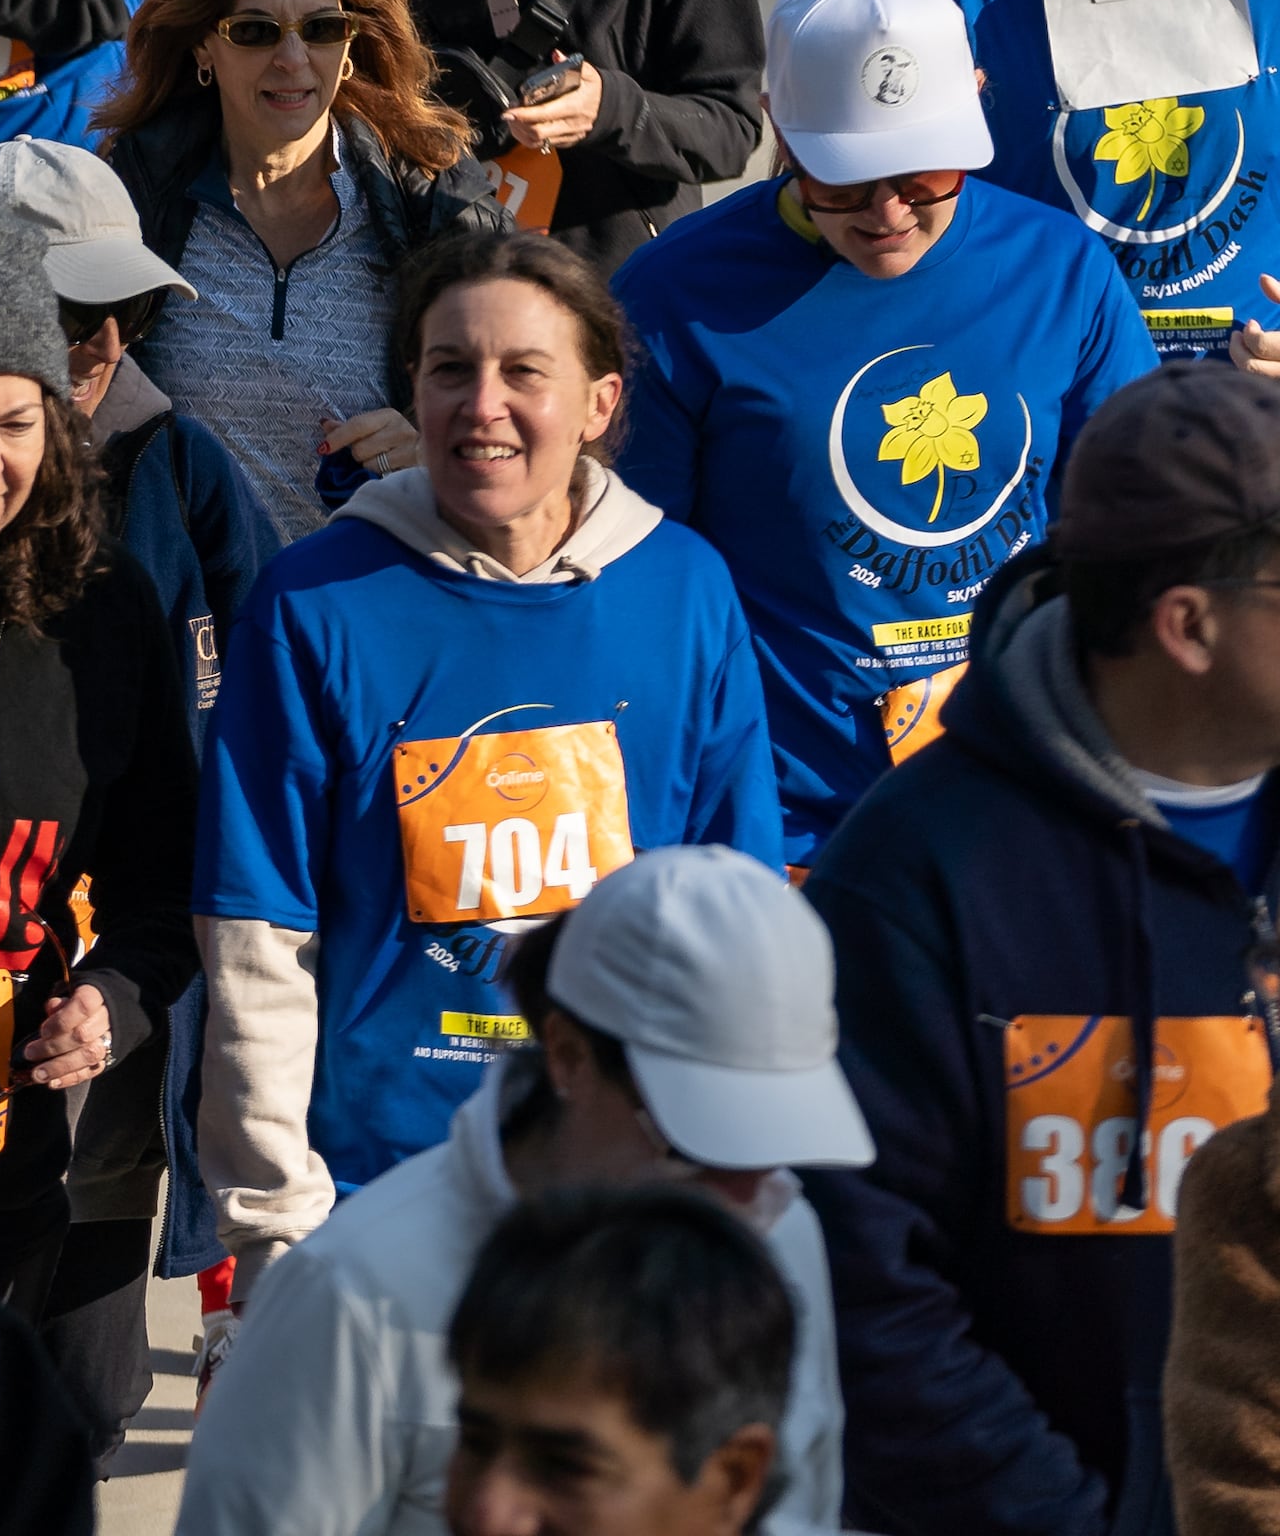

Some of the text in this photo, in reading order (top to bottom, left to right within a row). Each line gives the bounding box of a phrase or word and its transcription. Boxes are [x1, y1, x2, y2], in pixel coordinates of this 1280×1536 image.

[1200, 168, 1269, 256] Dash
[1142, 241, 1242, 299] 5K/1K RUN/WALK
[1156, 316, 1170, 327] 1.5
[1175, 315, 1213, 327] MILLION
[840, 527, 994, 594] Daffodil
[848, 564, 882, 590] 2024
[896, 621, 965, 640] THE RACE FOR
[945, 637, 969, 649] CHILD
[856, 658, 871, 667] AND
[486, 769, 545, 787] OnTime
[443, 812, 598, 911] 704
[424, 942, 461, 973] 2024
[467, 1019, 522, 1036] THE RACE
[414, 1047, 431, 1057] AND
[432, 1049, 482, 1062] SUPPORTING
